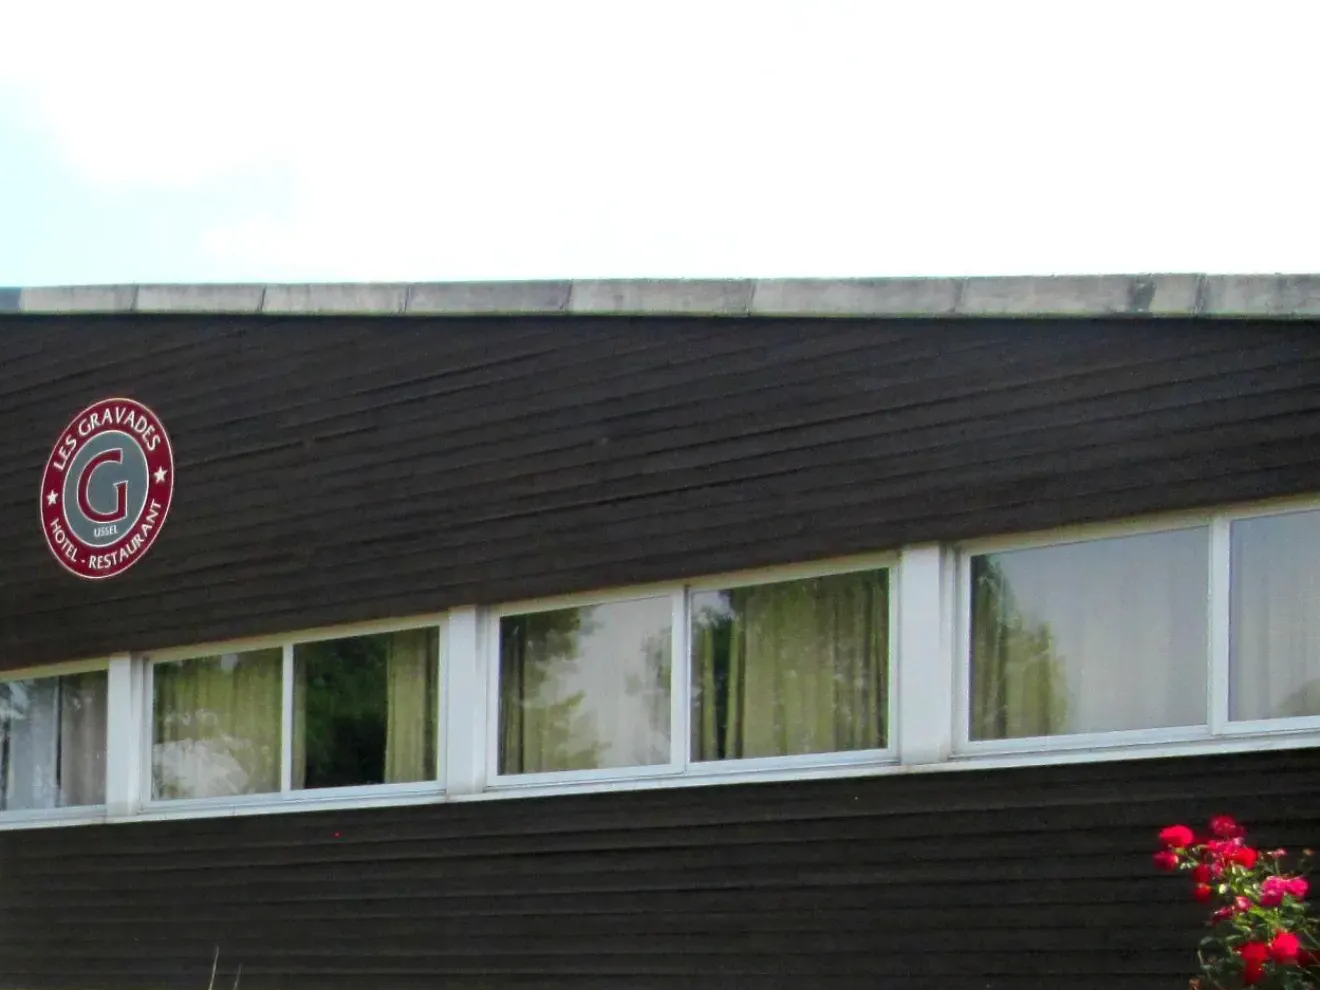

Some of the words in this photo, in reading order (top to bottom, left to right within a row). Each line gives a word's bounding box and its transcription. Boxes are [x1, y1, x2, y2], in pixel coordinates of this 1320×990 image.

[53, 434, 77, 471] LES
[78, 406, 161, 451] GRAVADES
[77, 448, 129, 523] G
[50, 518, 78, 562] HOTEL
[88, 498, 162, 569] RESTAURANT
[93, 525, 118, 538] USSEL
